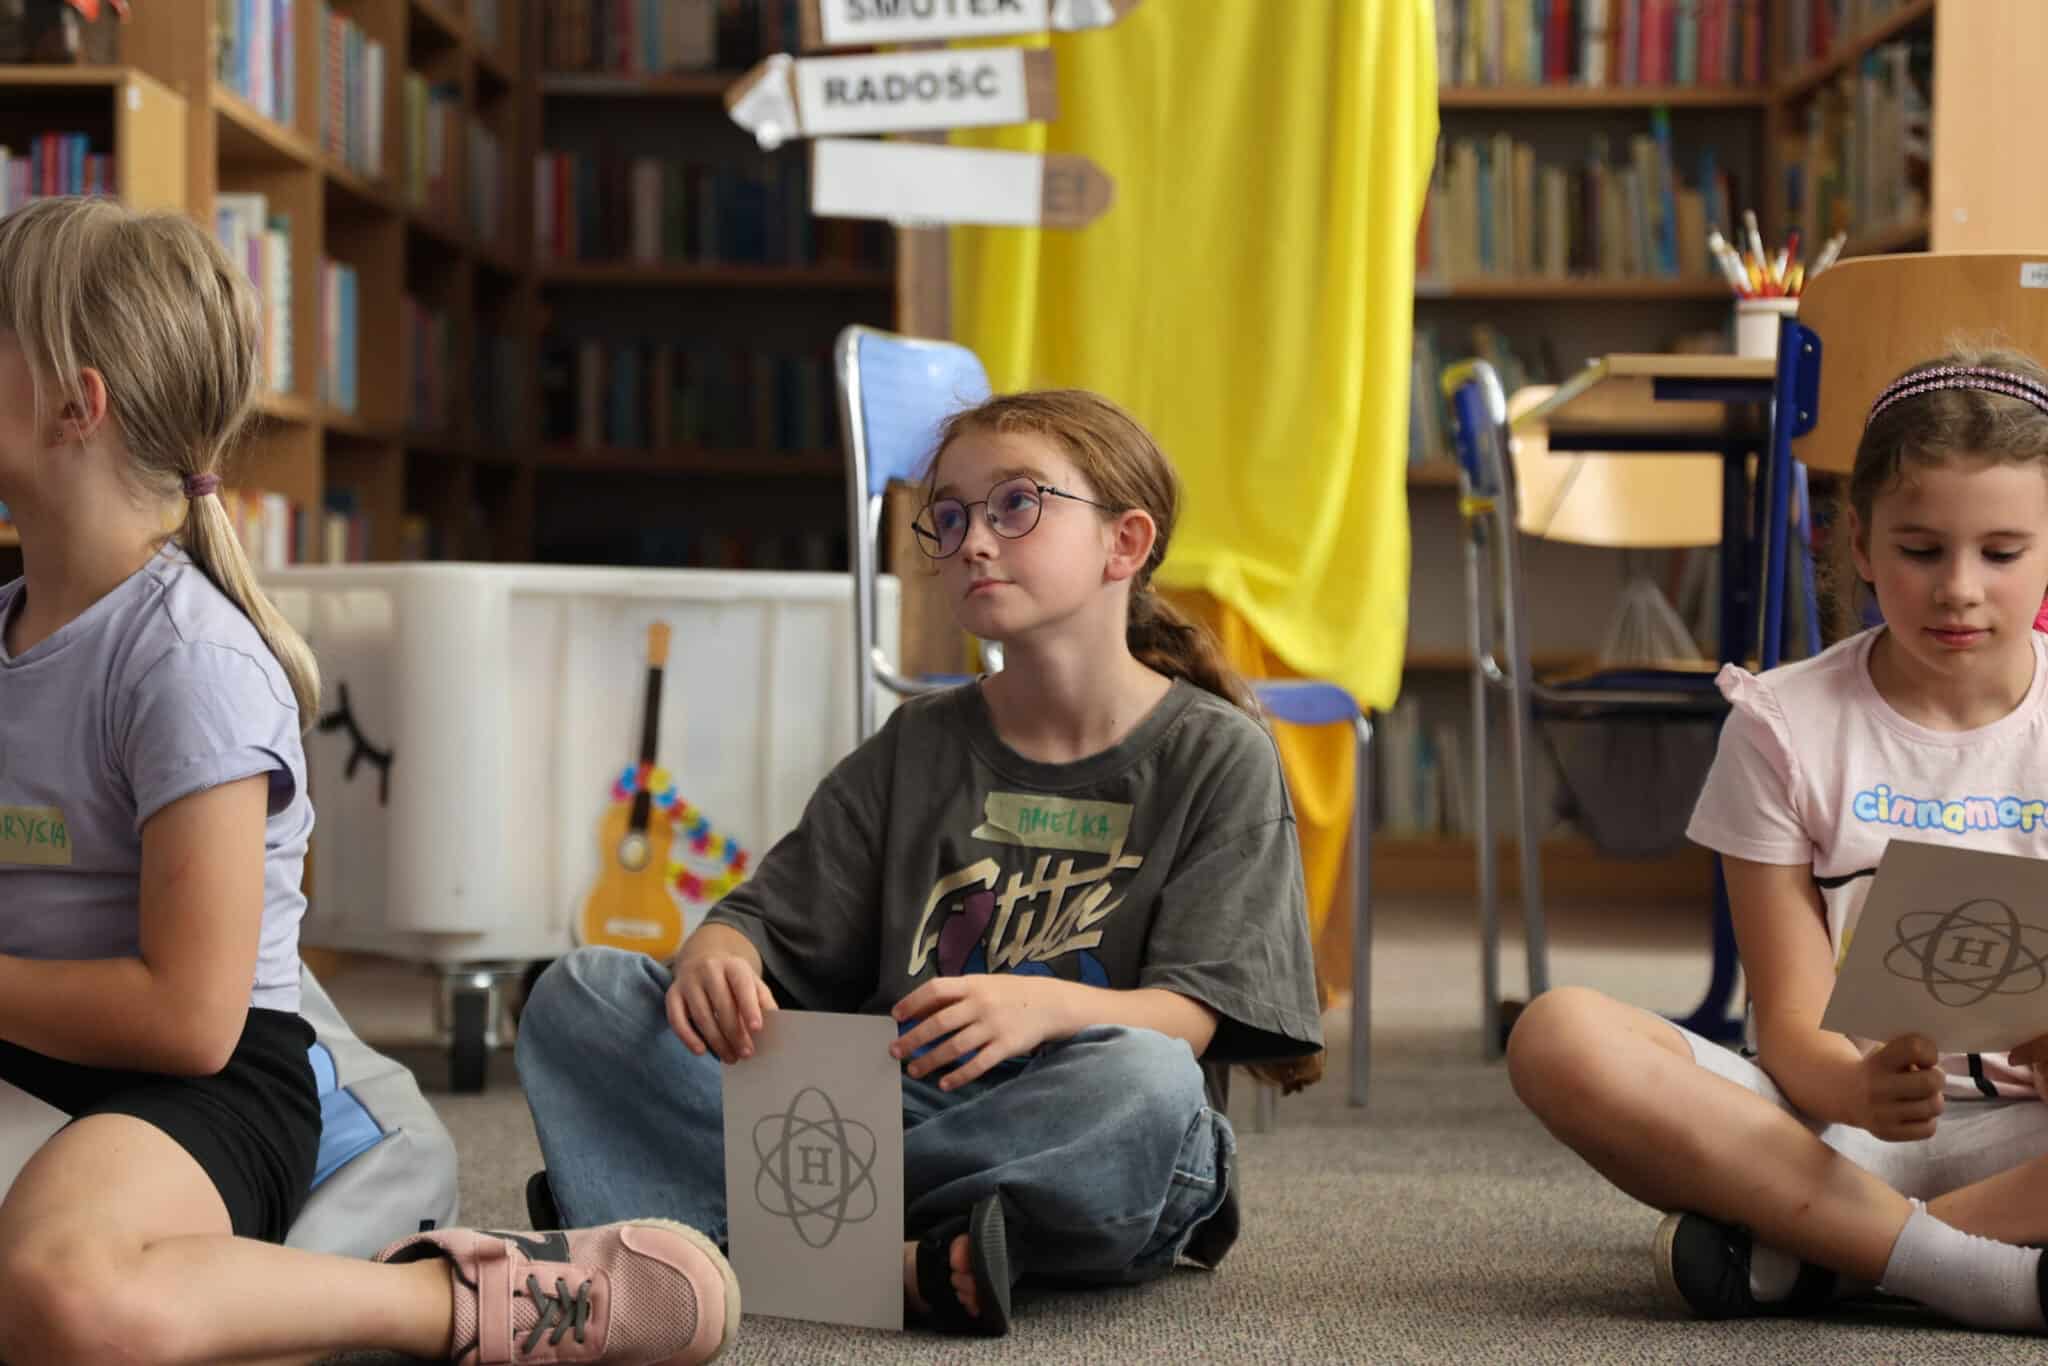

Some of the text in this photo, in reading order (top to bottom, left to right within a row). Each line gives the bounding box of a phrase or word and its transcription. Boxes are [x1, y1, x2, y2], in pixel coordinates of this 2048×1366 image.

[1018, 806, 1112, 840] AMELKA
[1854, 784, 2048, 833] cinnamor
[0, 813, 66, 849] RYSIA
[1946, 936, 1999, 968] H
[797, 1145, 834, 1187] H
